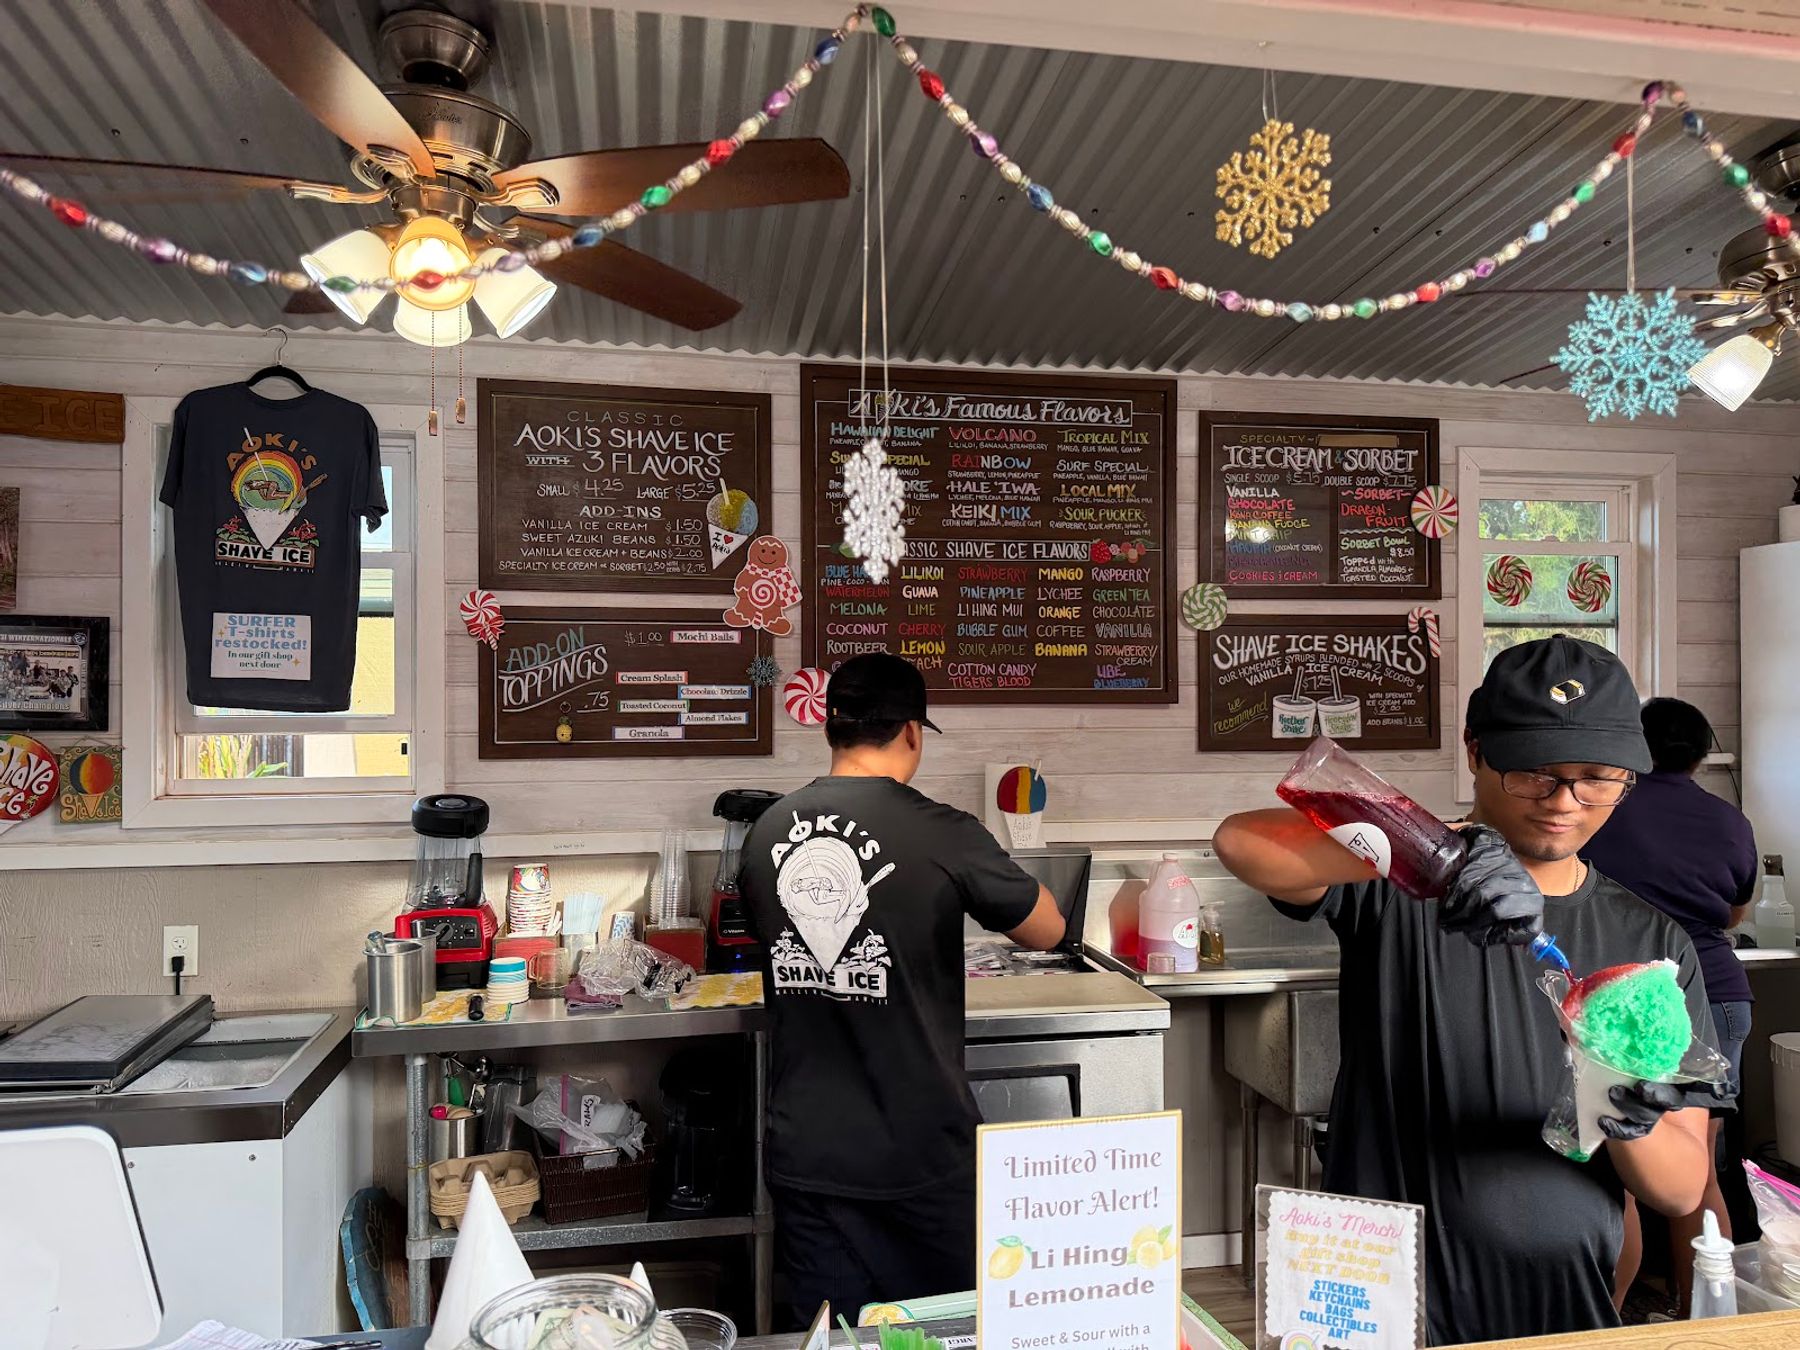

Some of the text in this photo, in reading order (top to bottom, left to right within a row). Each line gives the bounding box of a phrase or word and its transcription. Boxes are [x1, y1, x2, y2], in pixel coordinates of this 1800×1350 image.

[941, 396, 1038, 421] Famous
[1040, 400, 1130, 424] Flavors
[567, 411, 683, 426] CLASSIC
[513, 423, 735, 456] AOKI'S SHAVE ICE
[893, 425, 940, 439] DELIGHT
[948, 426, 1037, 442] VOLCANO
[1057, 429, 1151, 444] TROPICAL MIX
[1240, 434, 1305, 444] SPECIALTY
[226, 433, 317, 471] AOKI'S
[526, 451, 721, 482] WITH 3 FLAVORS
[952, 454, 1032, 469] RAINBOW
[1056, 459, 1149, 472] SURF SPECIAL
[1221, 444, 1266, 471] ICE
[1265, 446, 1334, 474] CREAM
[1342, 448, 1418, 476] SORBET
[1224, 472, 1250, 483] SINGLE
[1255, 472, 1280, 483] SCOOP
[1324, 475, 1353, 486] DOUBLE
[1356, 476, 1380, 487] SCOOP
[537, 484, 570, 497] SMALL
[637, 486, 674, 499] LARGE
[1060, 483, 1136, 498] LOCAL MIX
[1226, 485, 1280, 498] VANILLA
[1227, 497, 1296, 510] CHOCOLATE
[580, 505, 662, 519] ADD-INS
[950, 503, 1031, 521] KEIKI MIX
[1064, 506, 1144, 522] SOUR PUCKER
[1229, 510, 1293, 520] KONA COFFEE
[521, 519, 573, 530] VANILLA
[580, 521, 600, 530] ICE
[607, 522, 648, 532] CREAM
[1365, 515, 1408, 527] FRUIT
[521, 533, 563, 543] SWEET
[567, 534, 603, 544] AZUKI
[612, 535, 656, 545] BEANS
[1340, 536, 1410, 550] SORBET BOWL
[218, 543, 311, 563] SHAVE ICE
[520, 548, 563, 557] VANILLA
[566, 548, 582, 557] ICE
[583, 548, 618, 558] CREAM
[630, 549, 668, 559] BEANS
[904, 542, 1088, 560] ASSIC SHAVE ICE FLAVORS
[825, 564, 850, 579] BLUE
[900, 565, 945, 581] LILIKOI
[1038, 567, 1083, 581] MANGO
[1091, 567, 1151, 583] RASPBERRY
[1229, 570, 1317, 581] COOKIES CREAM
[902, 584, 939, 599] GUAVA
[960, 586, 1026, 600] PINEAPPLE
[1037, 587, 1083, 601] LYCHEE
[1092, 588, 1151, 603] GREEN TEA
[830, 602, 888, 616] MELONA
[908, 603, 936, 616] LIME
[971, 604, 997, 617] HING
[1002, 604, 1023, 617] MUI
[1038, 606, 1082, 619] ORANGE
[1092, 606, 1155, 618] CHOCOLATE
[227, 615, 296, 627] SURFER
[228, 626, 295, 639] T-shirts
[826, 622, 888, 636] COCONUT
[899, 622, 946, 638] CHERRY
[957, 623, 1028, 638] BUBBLE GUM
[1036, 625, 1086, 638] COFFEE
[1095, 623, 1153, 638] VANILLA
[215, 639, 307, 650] restocked!
[677, 633, 734, 642] Mochi Balls
[505, 626, 584, 672] ADD-ON
[826, 639, 892, 655] ROOTBEER
[900, 640, 945, 655] LEMON
[1035, 642, 1087, 657] BANANA
[1213, 634, 1426, 675] SHAVE ICE SHAKES
[255, 651, 270, 660] gift
[273, 651, 293, 661] shop
[499, 645, 608, 706] TOPPINGS
[948, 662, 1037, 677] COTTON CANDY
[1219, 670, 1238, 686] OUR
[1238, 657, 1282, 679] HOMEMADE
[1285, 654, 1315, 664] SYRUPS
[1319, 654, 1359, 668] BLENDED
[1372, 662, 1381, 674] 2
[1384, 667, 1415, 687] SCOOPS
[1246, 663, 1383, 686] VANILLA ICE CREAM
[620, 674, 683, 683] Cream Splash
[949, 677, 1031, 688] TIGERS BLOOD
[629, 729, 669, 738] Granola
[771, 814, 880, 869] AOKI'S
[777, 966, 880, 990] SHAVE ICE
[1004, 1148, 1162, 1179] Limited Time
[1005, 1186, 1158, 1220] Flavor Alert!
[1279, 1207, 1404, 1239] Aoki's Merch!
[1031, 1246, 1128, 1269] Li Hing
[1009, 1277, 1155, 1308] Lemonade
[1313, 1280, 1366, 1298] STICKERS
[1309, 1290, 1370, 1310] KEYCHAINS
[1325, 1304, 1353, 1319] BAGS
[1299, 1310, 1377, 1333] COLLECTIBLES
[1011, 1324, 1150, 1350] Sweet & Sour with a
[1328, 1327, 1350, 1340] ART
